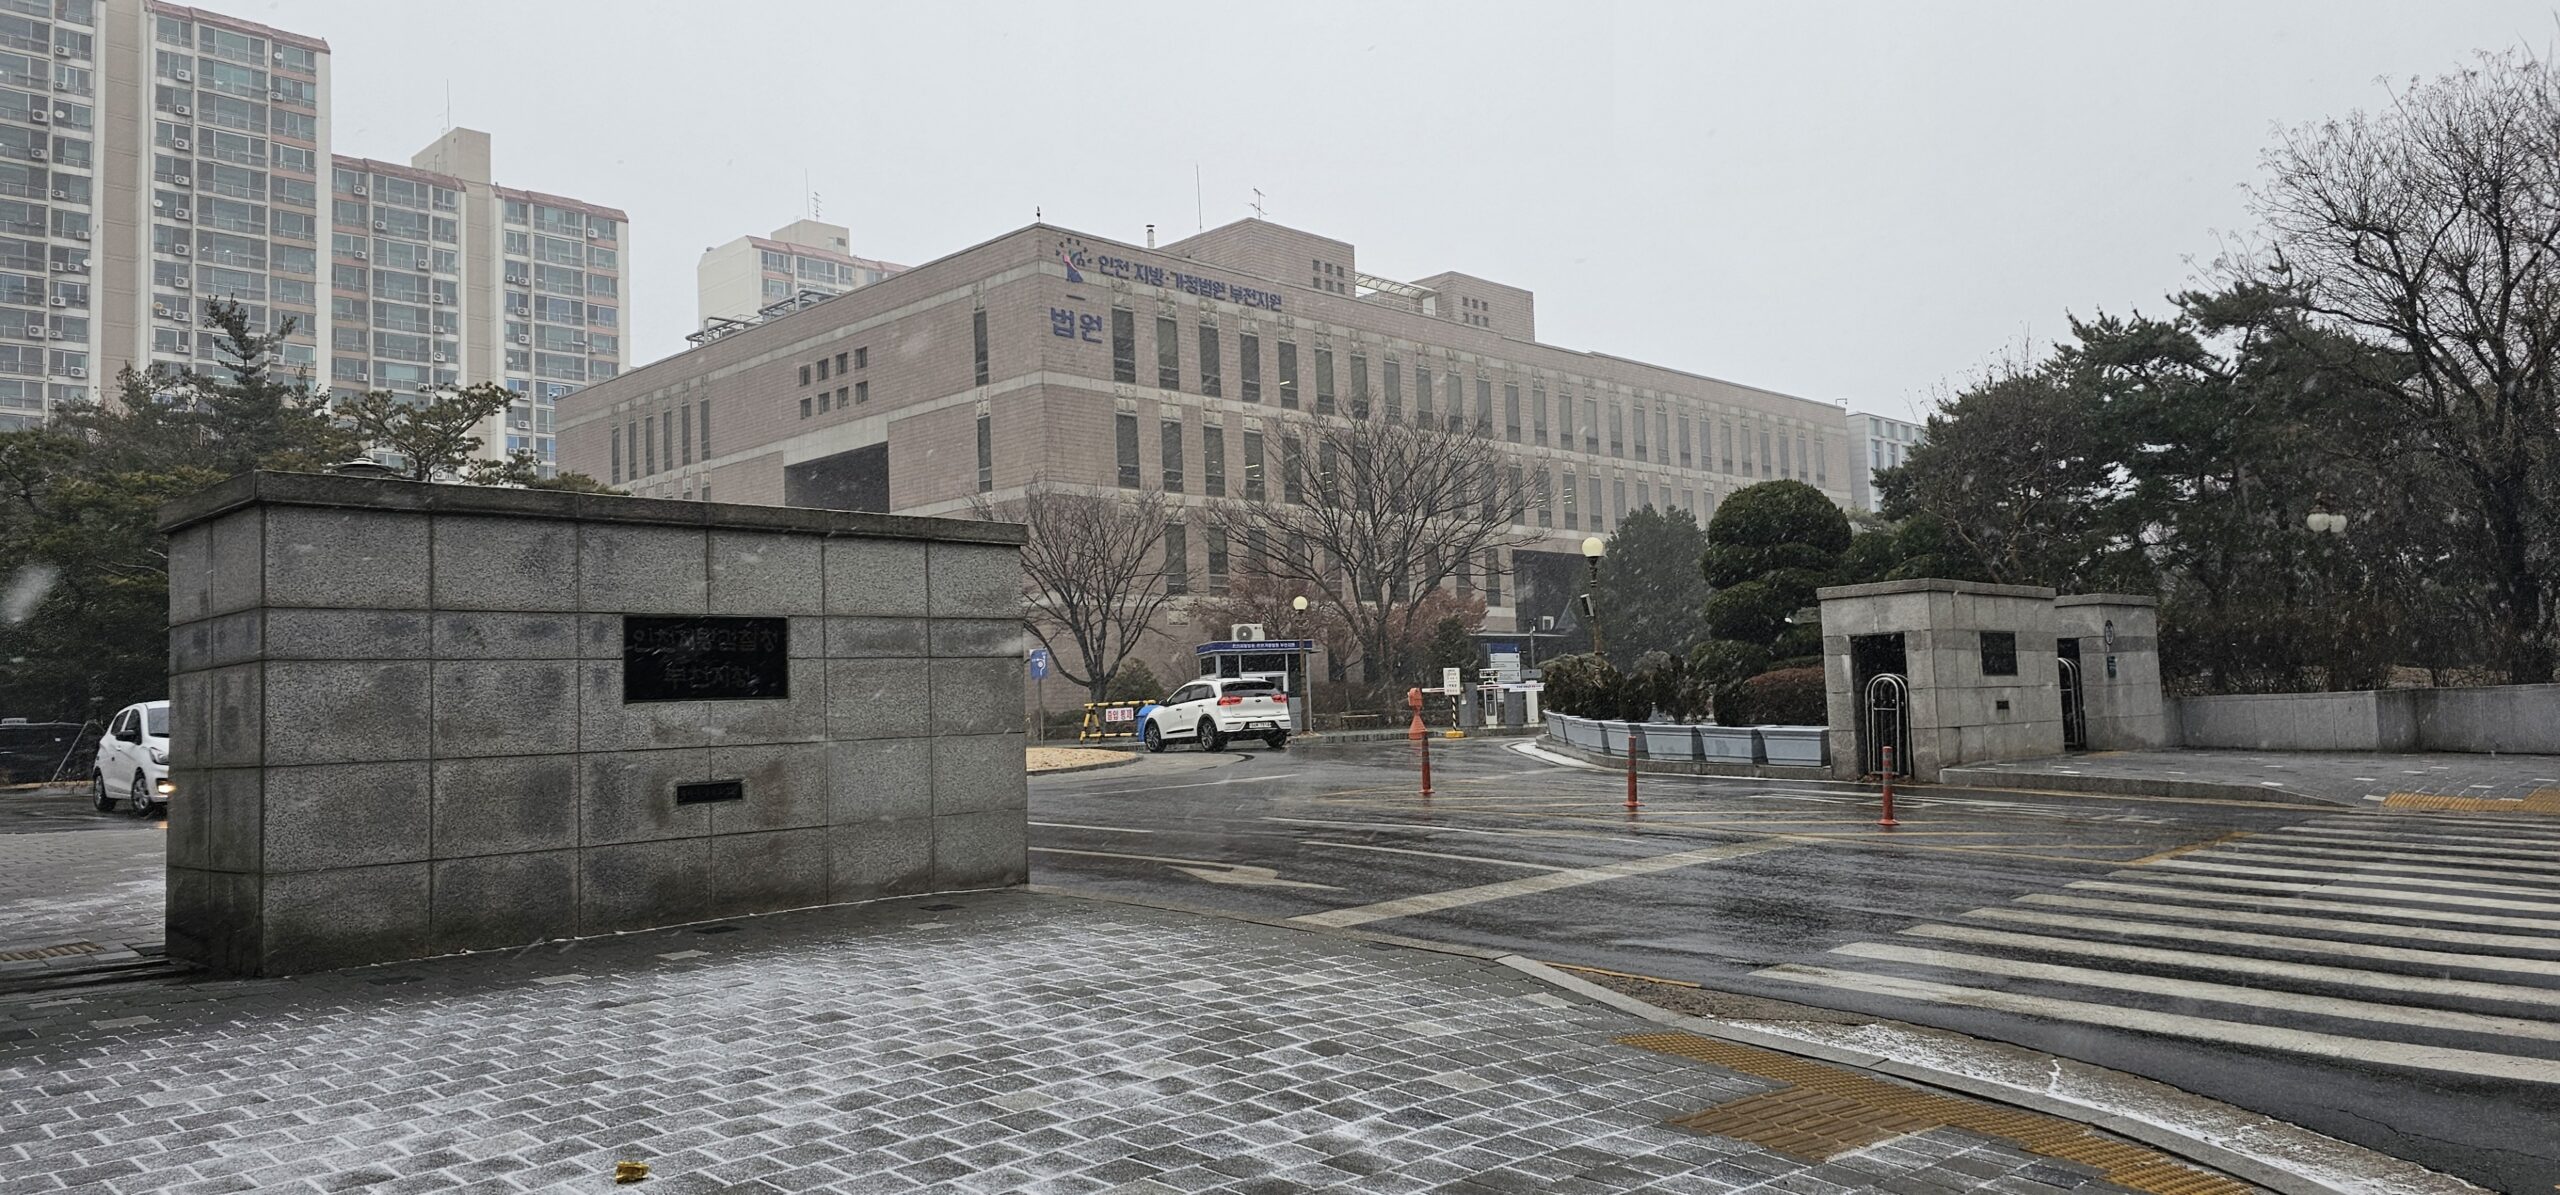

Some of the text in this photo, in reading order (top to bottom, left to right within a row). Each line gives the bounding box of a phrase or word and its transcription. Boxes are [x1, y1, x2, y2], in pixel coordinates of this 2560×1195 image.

[1098, 255, 1129, 280] 인천
[1230, 284, 1282, 312] 부천지원
[1050, 307, 1103, 344] 법원
